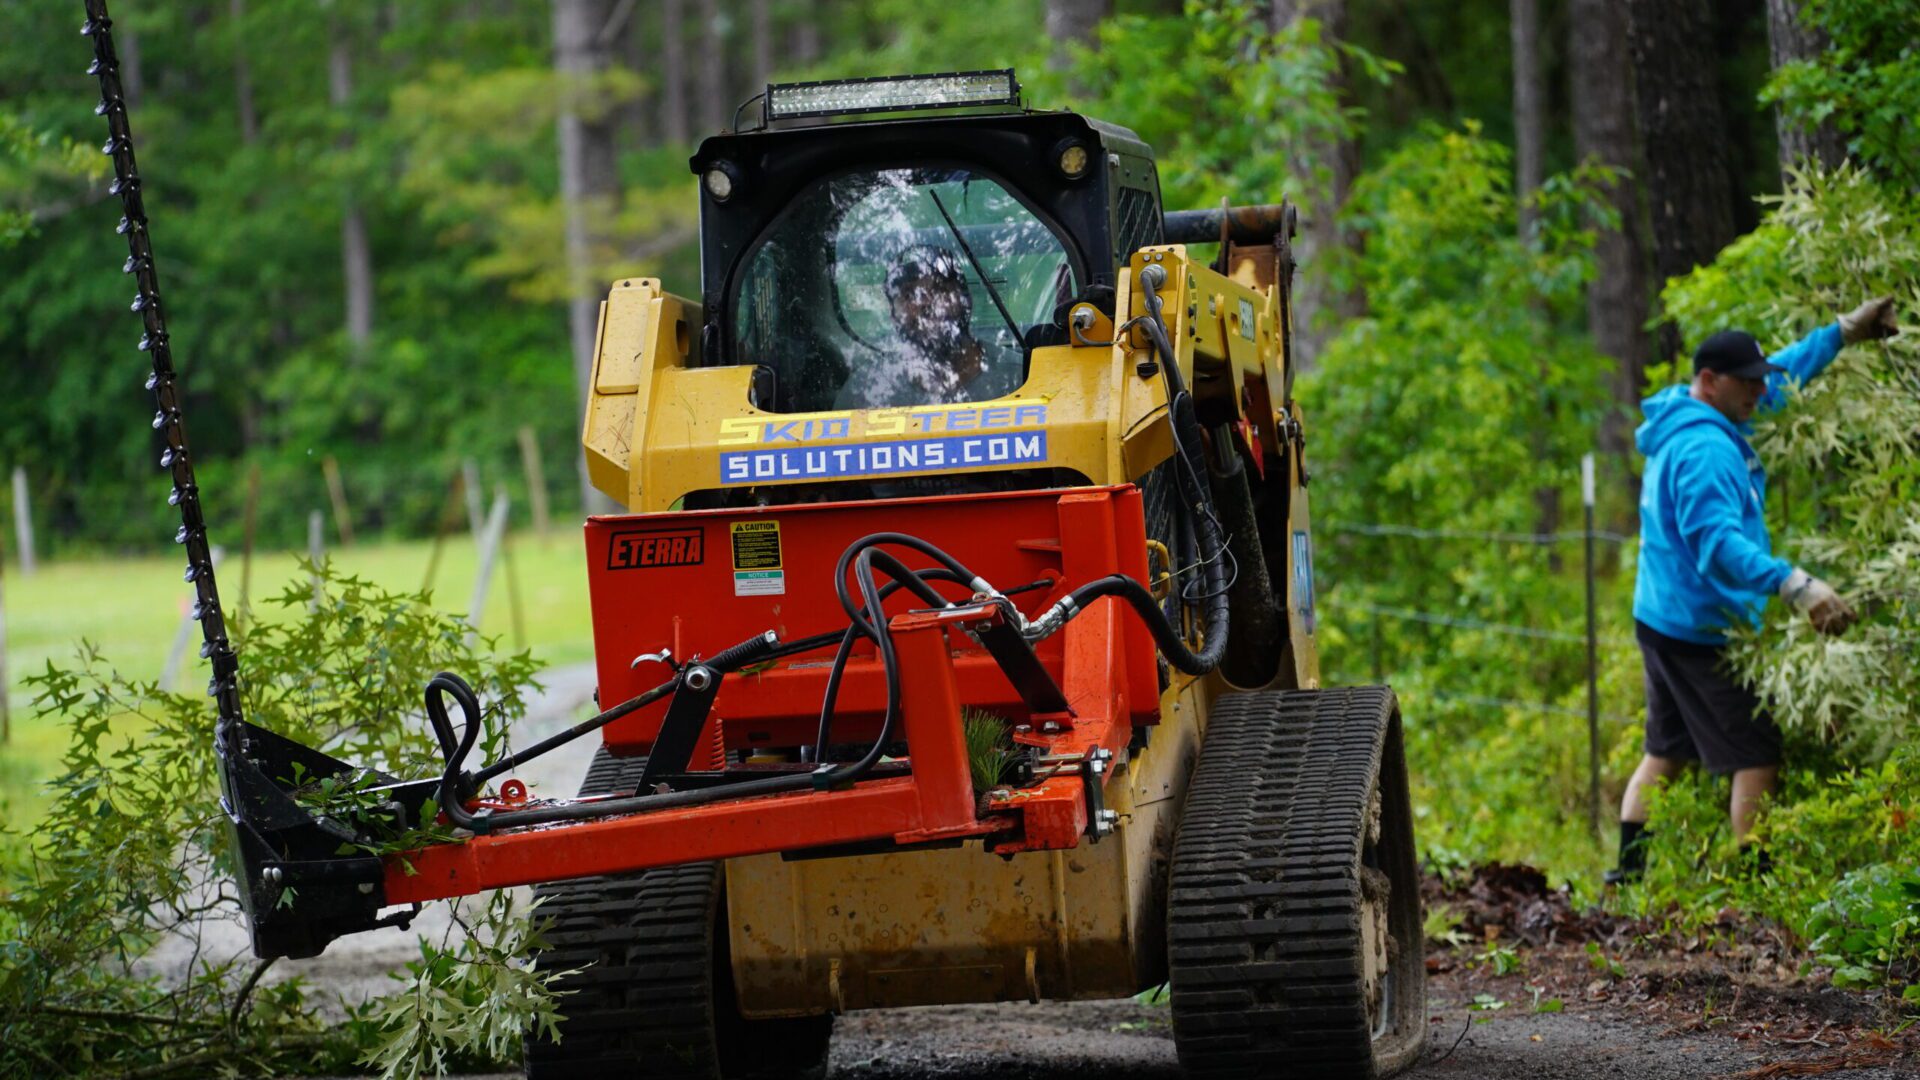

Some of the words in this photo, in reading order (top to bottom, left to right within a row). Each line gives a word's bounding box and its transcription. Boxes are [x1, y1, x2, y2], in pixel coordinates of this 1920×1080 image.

[718, 412, 851, 445] SKID
[865, 398, 1049, 437] STEER
[728, 435, 1040, 479] SOLUTIONS.COM
[610, 530, 701, 568] ETERRA
